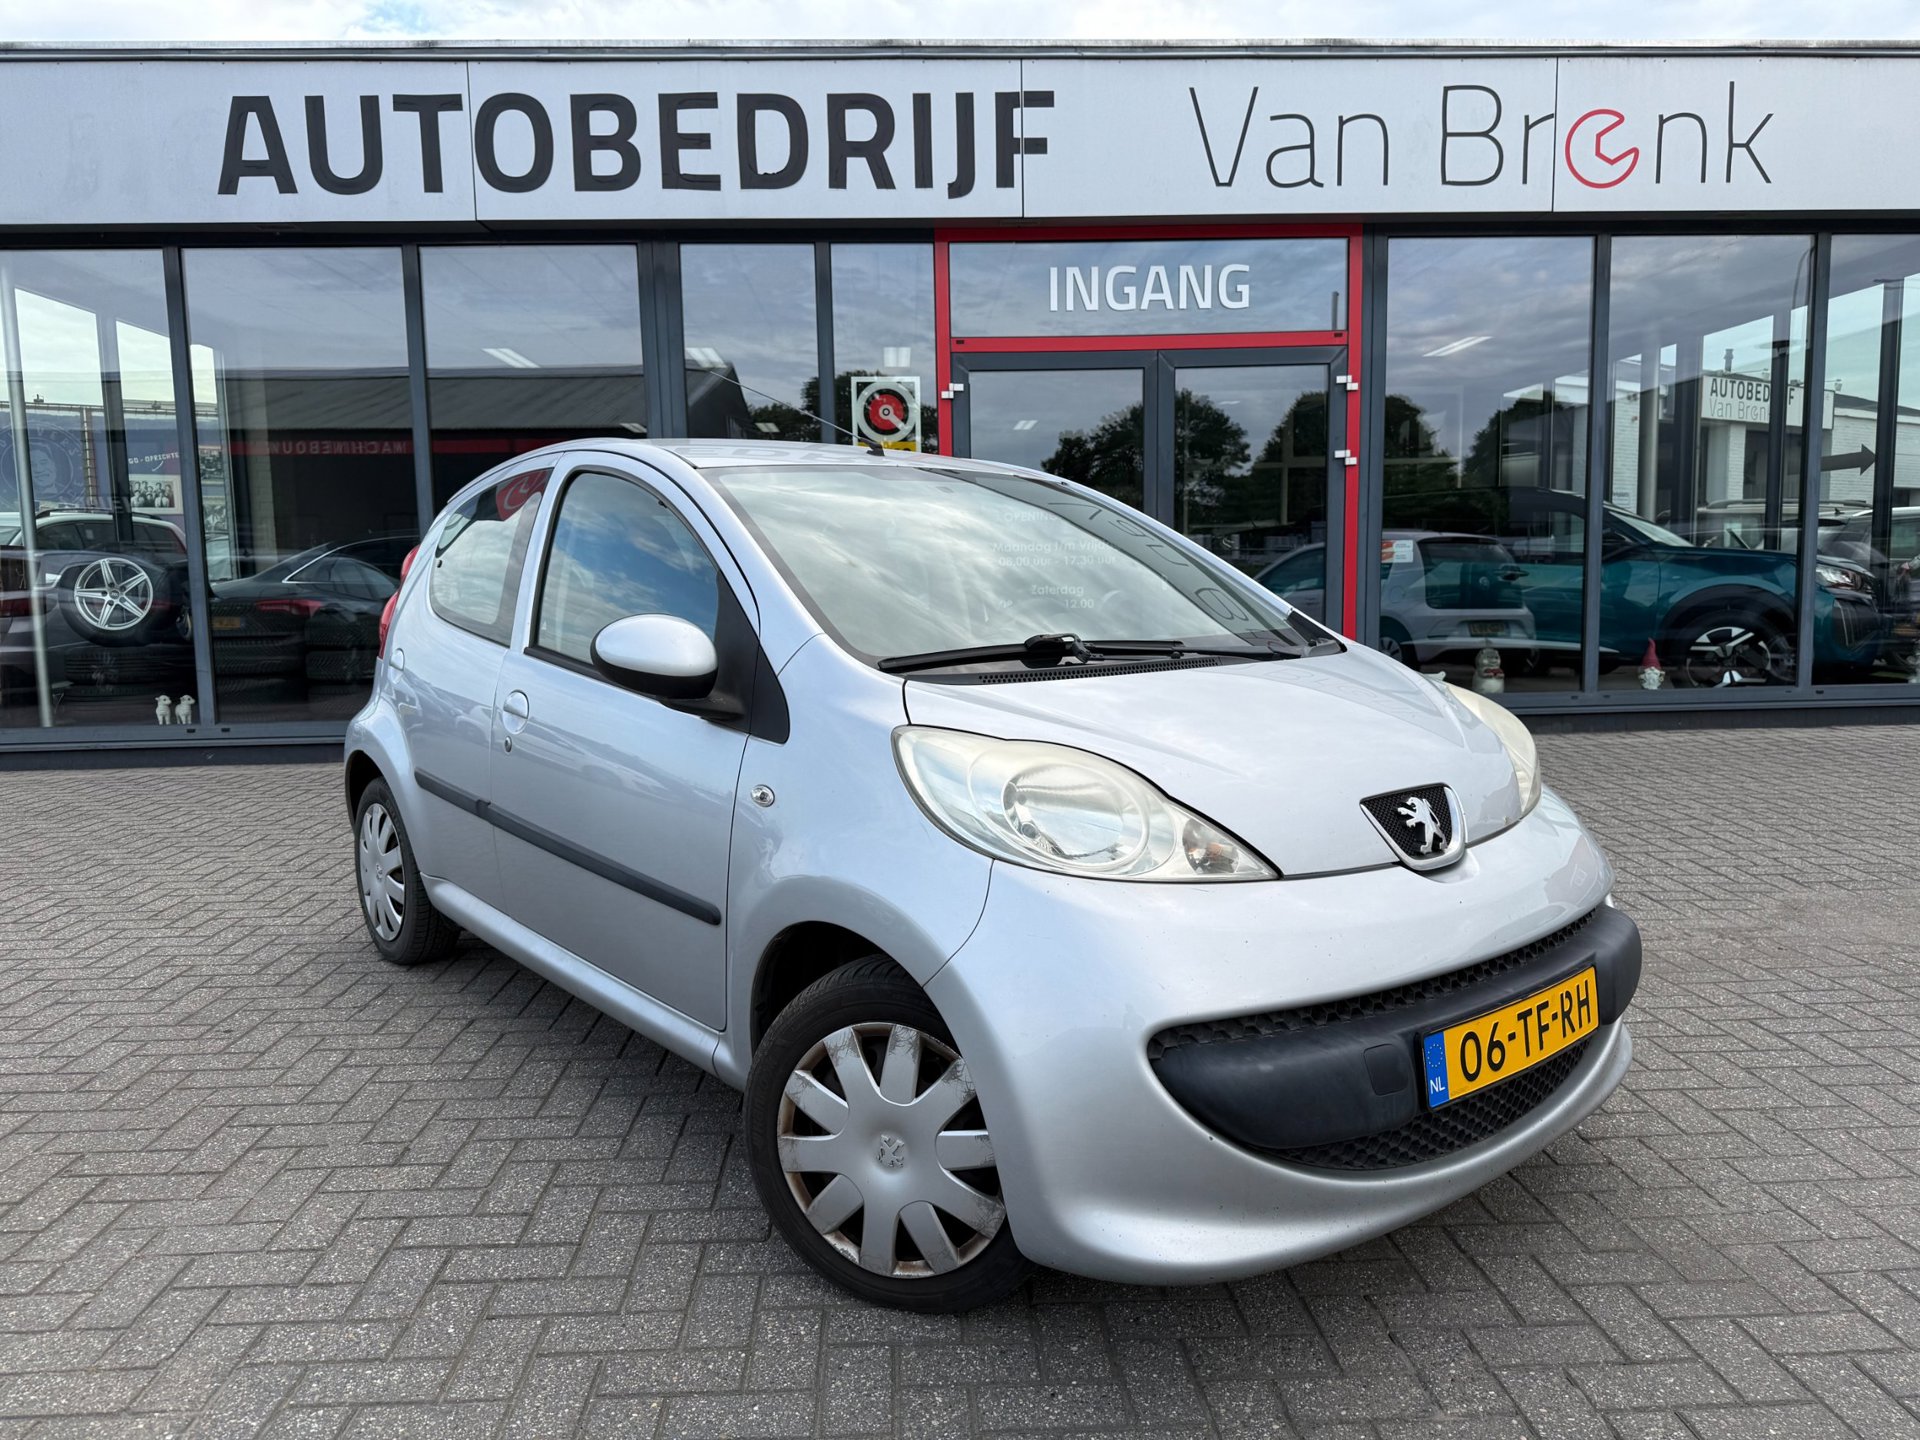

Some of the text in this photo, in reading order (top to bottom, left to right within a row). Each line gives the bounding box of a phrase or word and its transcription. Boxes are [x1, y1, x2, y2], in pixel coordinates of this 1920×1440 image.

[218, 90, 1054, 199] AUTOBEDRIJF
[1189, 86, 1324, 189] Van
[1049, 264, 1251, 312] INGANG
[1710, 399, 1732, 418] Van
[1031, 584, 1084, 597] Zaterdag
[1460, 979, 1591, 1082] 06-TF-RH
[1430, 1077, 1445, 1094] NL
